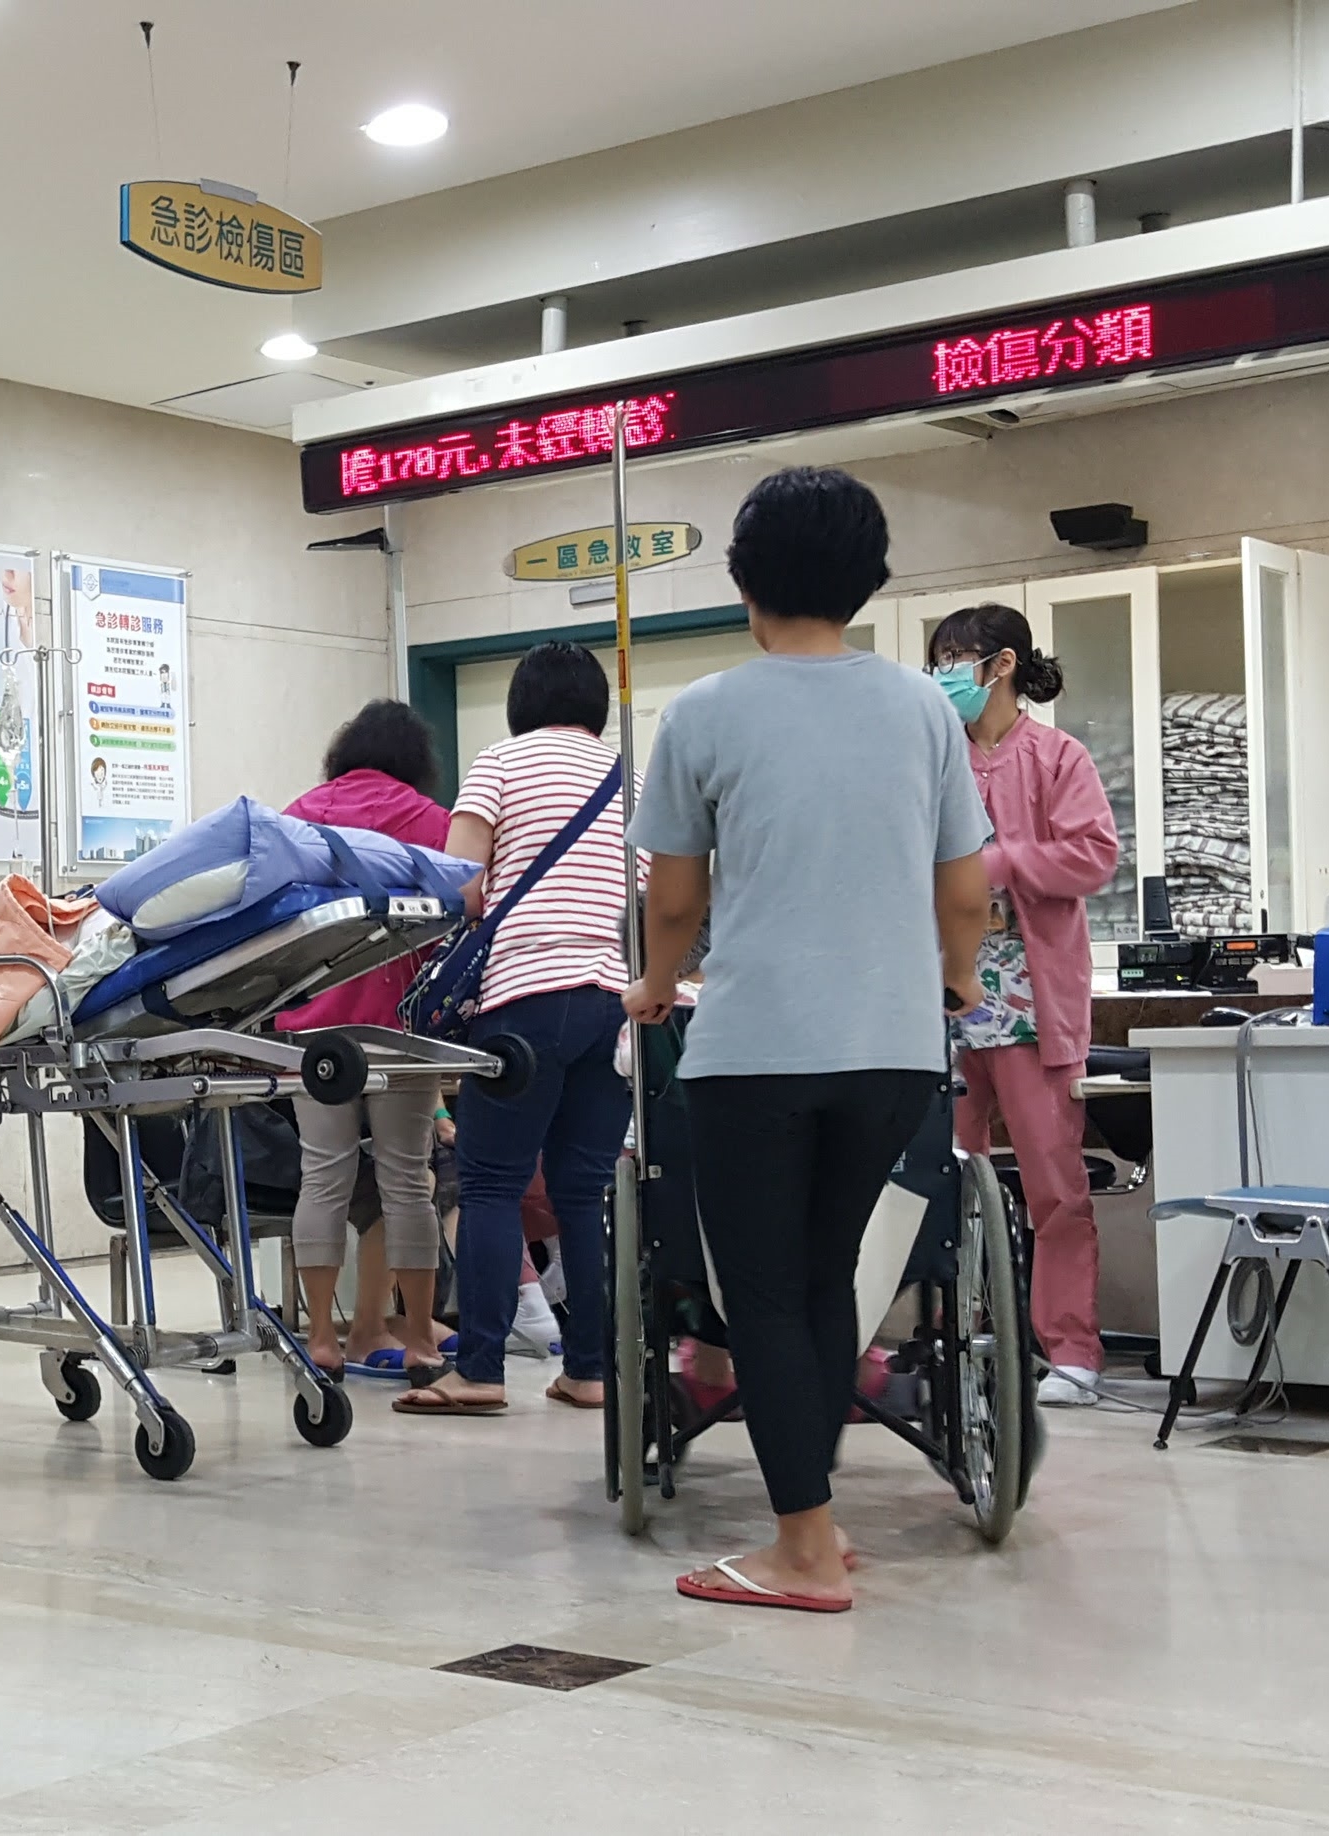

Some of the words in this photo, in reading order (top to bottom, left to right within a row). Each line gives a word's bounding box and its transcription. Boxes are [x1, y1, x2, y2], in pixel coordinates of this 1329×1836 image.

[150, 194, 305, 279] 急診檢傷區
[94, 610, 165, 636] 急診轉診服務
